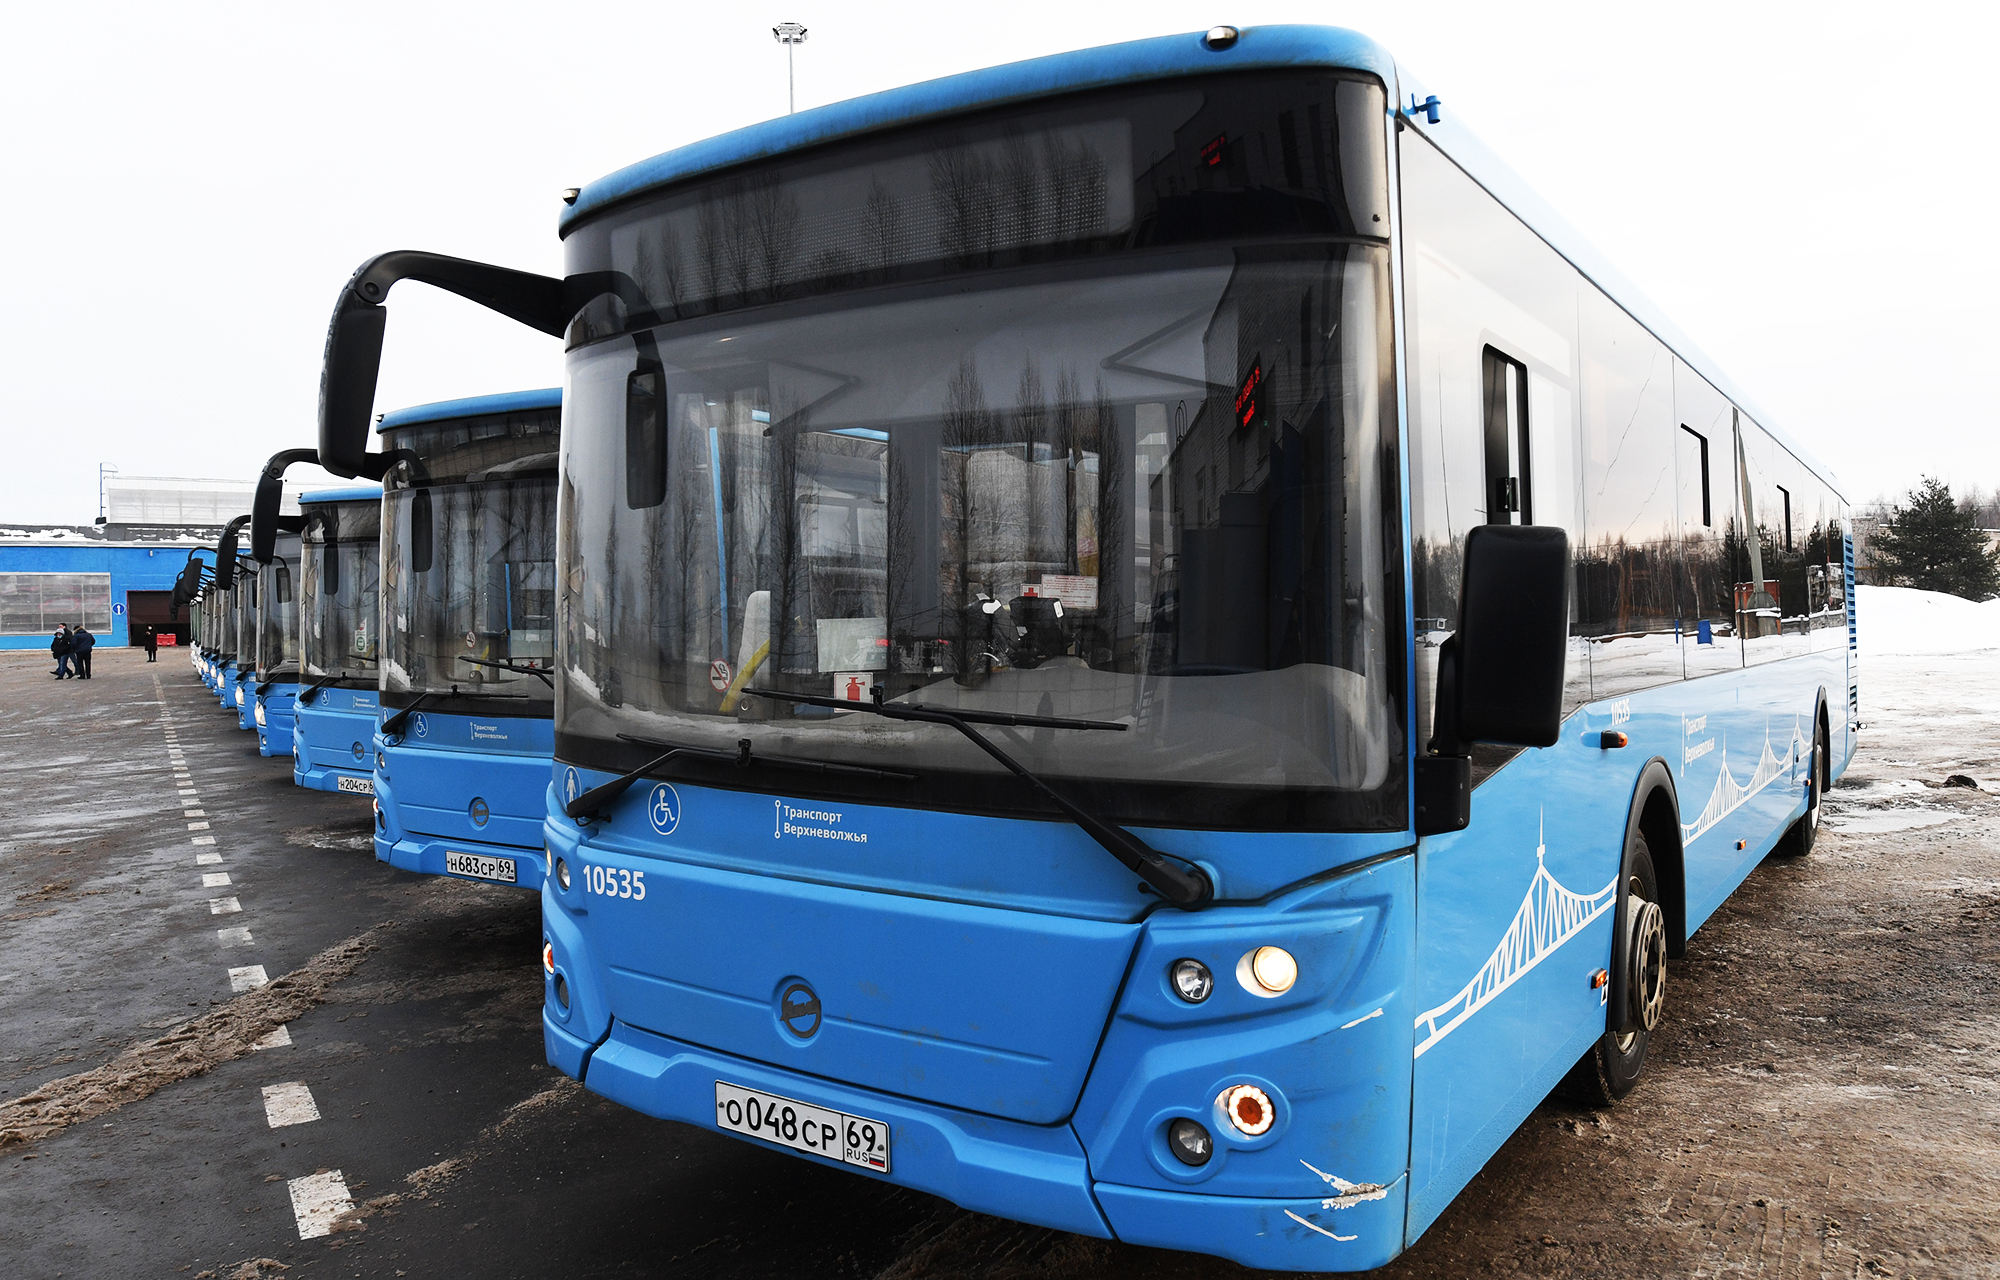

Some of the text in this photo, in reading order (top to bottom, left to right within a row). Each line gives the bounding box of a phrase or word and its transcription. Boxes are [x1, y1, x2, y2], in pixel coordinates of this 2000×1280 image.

[1611, 698, 1630, 726] 10535
[783, 805, 842, 825] Транспорт
[783, 822, 868, 843] Верхневолжья
[450, 856, 511, 876] Н683СР 69
[583, 865, 646, 900] 10535
[846, 1120, 876, 1152] 69
[846, 1148, 868, 1162] RUS
